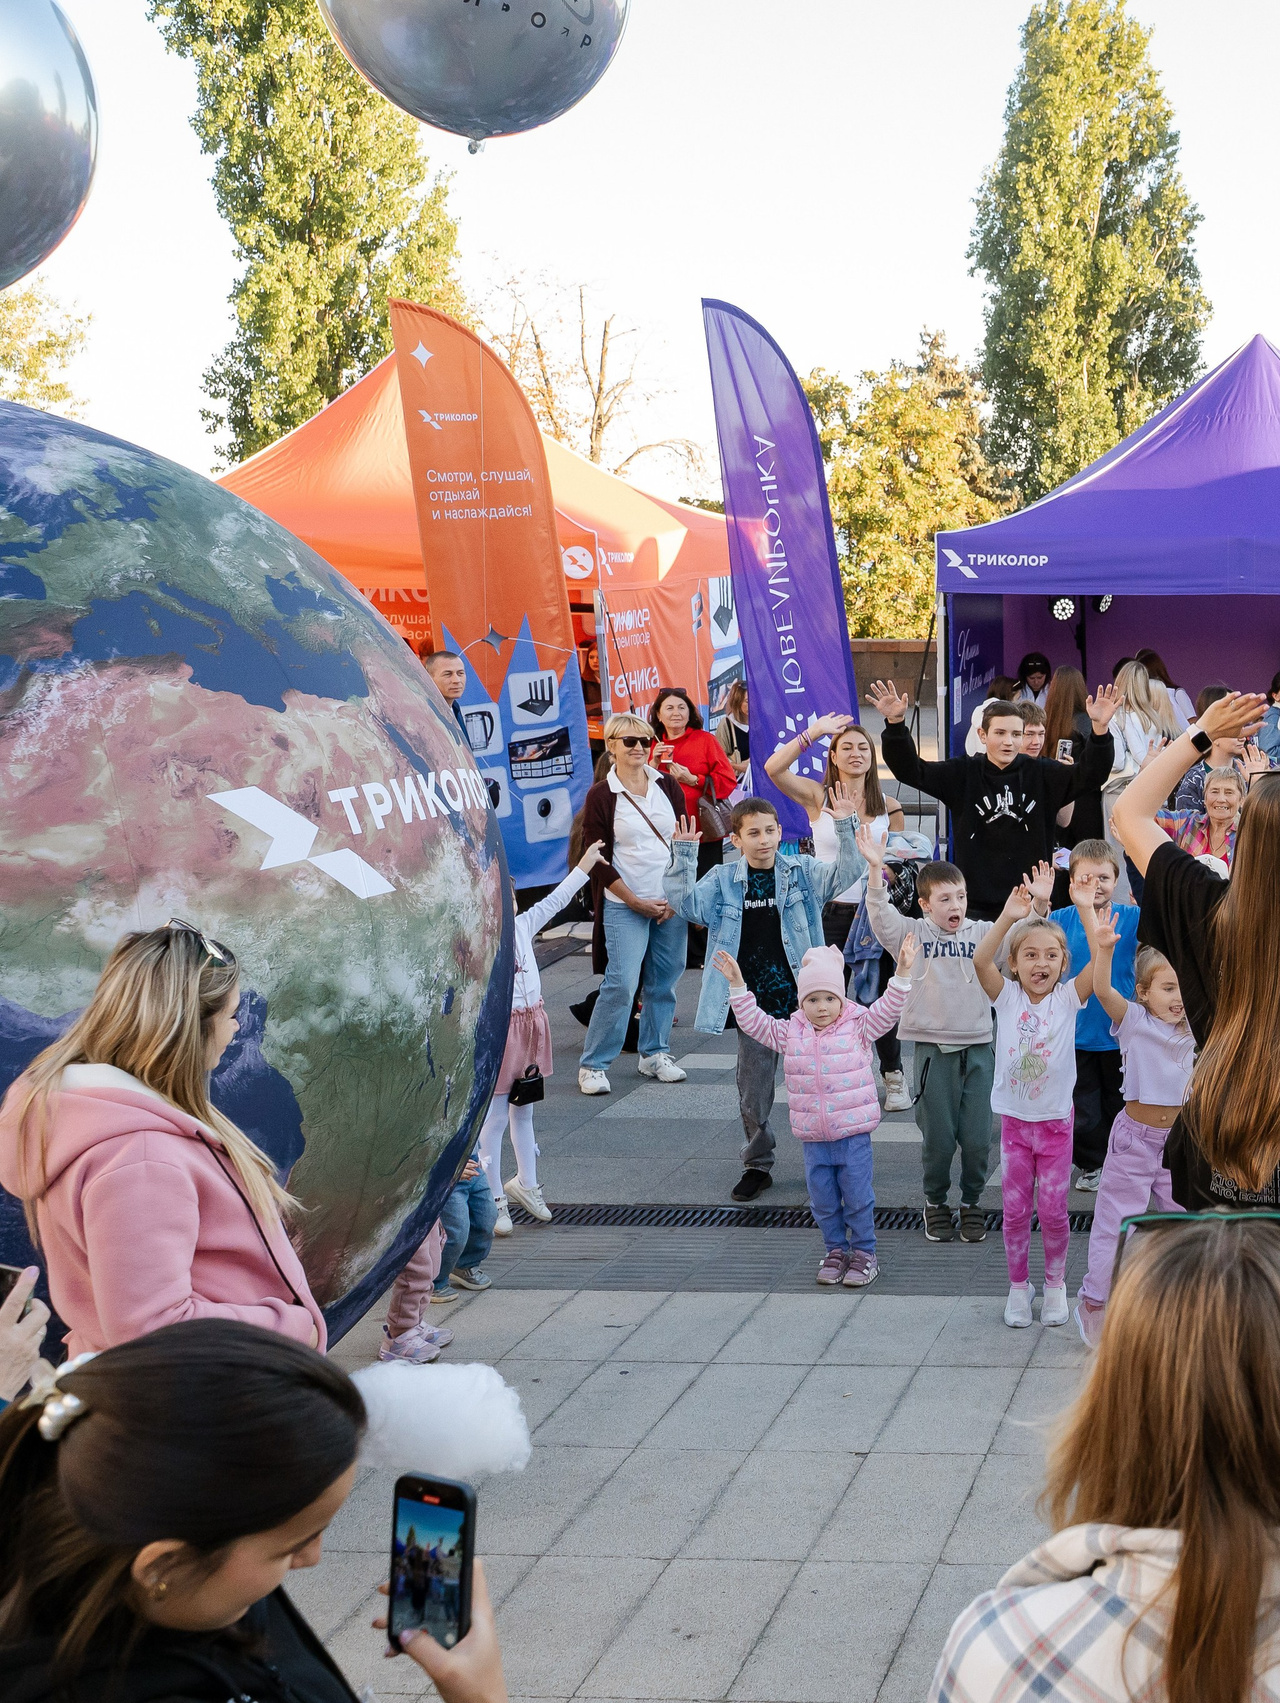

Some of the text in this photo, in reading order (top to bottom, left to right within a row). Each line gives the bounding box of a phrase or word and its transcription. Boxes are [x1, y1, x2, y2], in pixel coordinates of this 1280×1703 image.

[433, 413, 478, 421] ТРИКОЛОР
[426, 468, 534, 485] Смотри, слушай,
[429, 488, 480, 503] отдыхай
[432, 504, 533, 520] и наслаждайся!
[607, 552, 634, 563] ТРИКОЛОР
[967, 554, 1049, 567] ТРИКОЛОР
[922, 940, 976, 960] FUTURE
